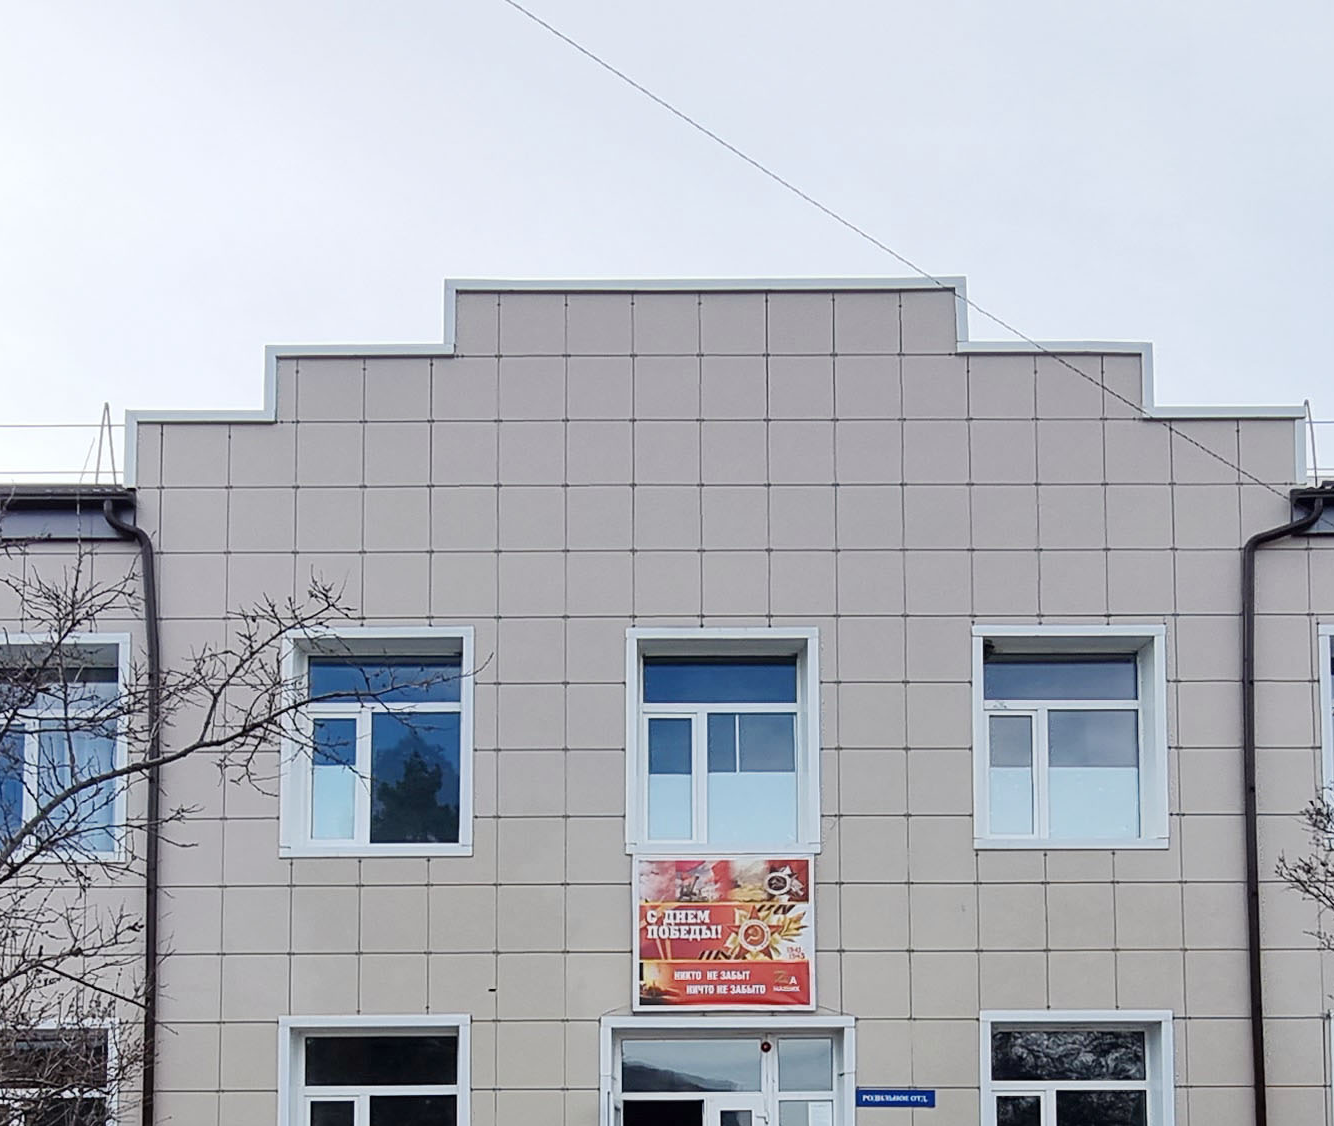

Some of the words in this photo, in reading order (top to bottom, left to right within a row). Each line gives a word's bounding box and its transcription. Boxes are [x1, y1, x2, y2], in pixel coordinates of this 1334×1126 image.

[647, 910, 657, 923] С
[663, 910, 710, 925] ДНЕМ
[647, 925, 722, 940] ПОБЕДЫ!
[674, 970, 702, 981] НИКТО
[707, 970, 719, 981] НЕ
[720, 970, 750, 981] ЗАБЫТ
[686, 984, 714, 995] НИЧТО
[717, 984, 729, 995] НЕ
[730, 984, 766, 995] ЗАБЫТО
